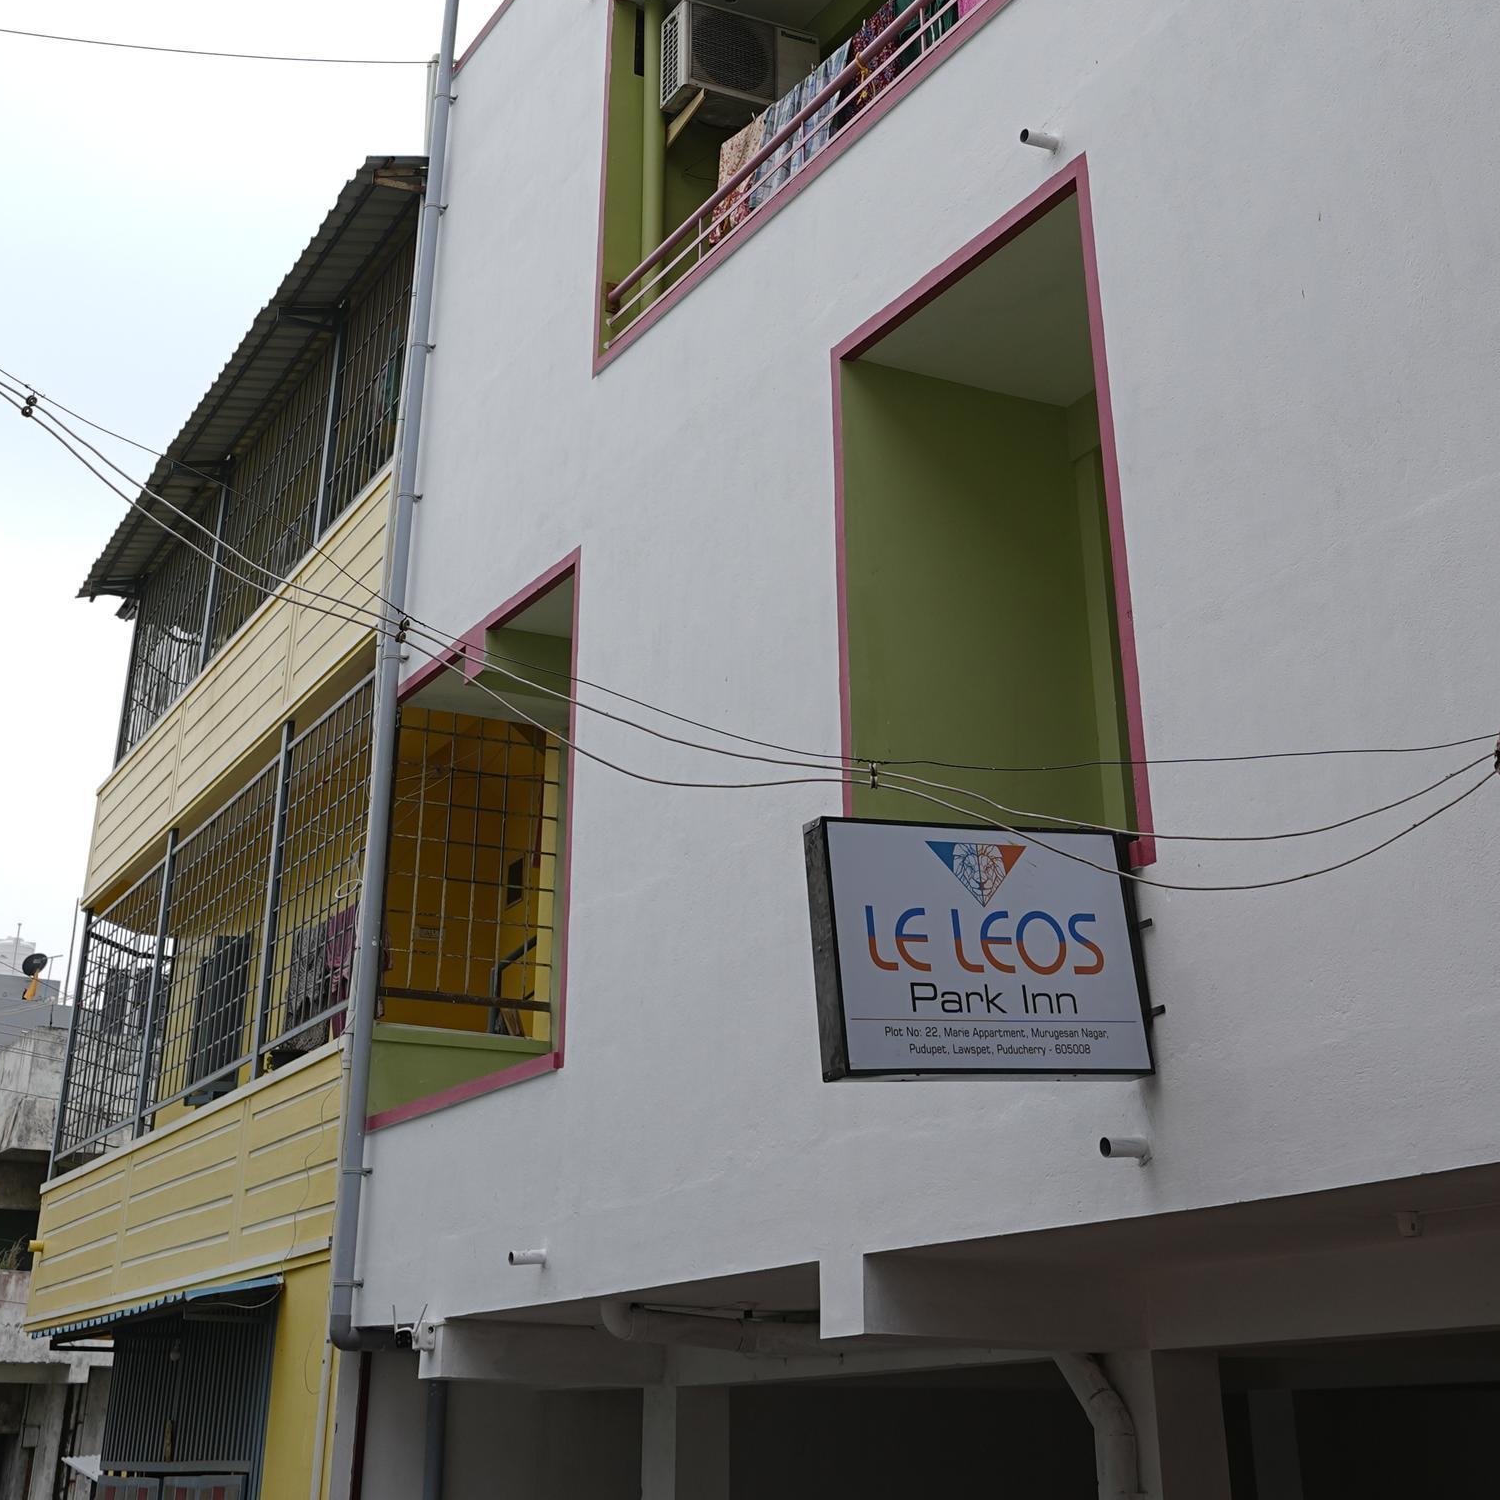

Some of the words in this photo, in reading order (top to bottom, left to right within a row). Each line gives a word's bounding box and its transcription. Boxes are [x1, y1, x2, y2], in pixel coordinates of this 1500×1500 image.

[865, 905, 932, 972] LE
[951, 908, 1105, 976] LEOS
[910, 982, 1008, 1014] Park
[1021, 984, 1078, 1014] Inn
[884, 1026, 904, 1037] Plot
[906, 1026, 922, 1037] No:
[925, 1026, 941, 1039] 22,
[943, 1027, 970, 1038] Marie
[972, 1027, 1029, 1040] Appartment,
[1031, 1028, 1079, 1040] Murugesan
[1081, 1028, 1109, 1040] Nagar,
[909, 1043, 950, 1057] Pudupet,
[953, 1044, 994, 1057] Lawspet,
[996, 1044, 1046, 1057] Puducherry
[1054, 1043, 1092, 1055] 605008
